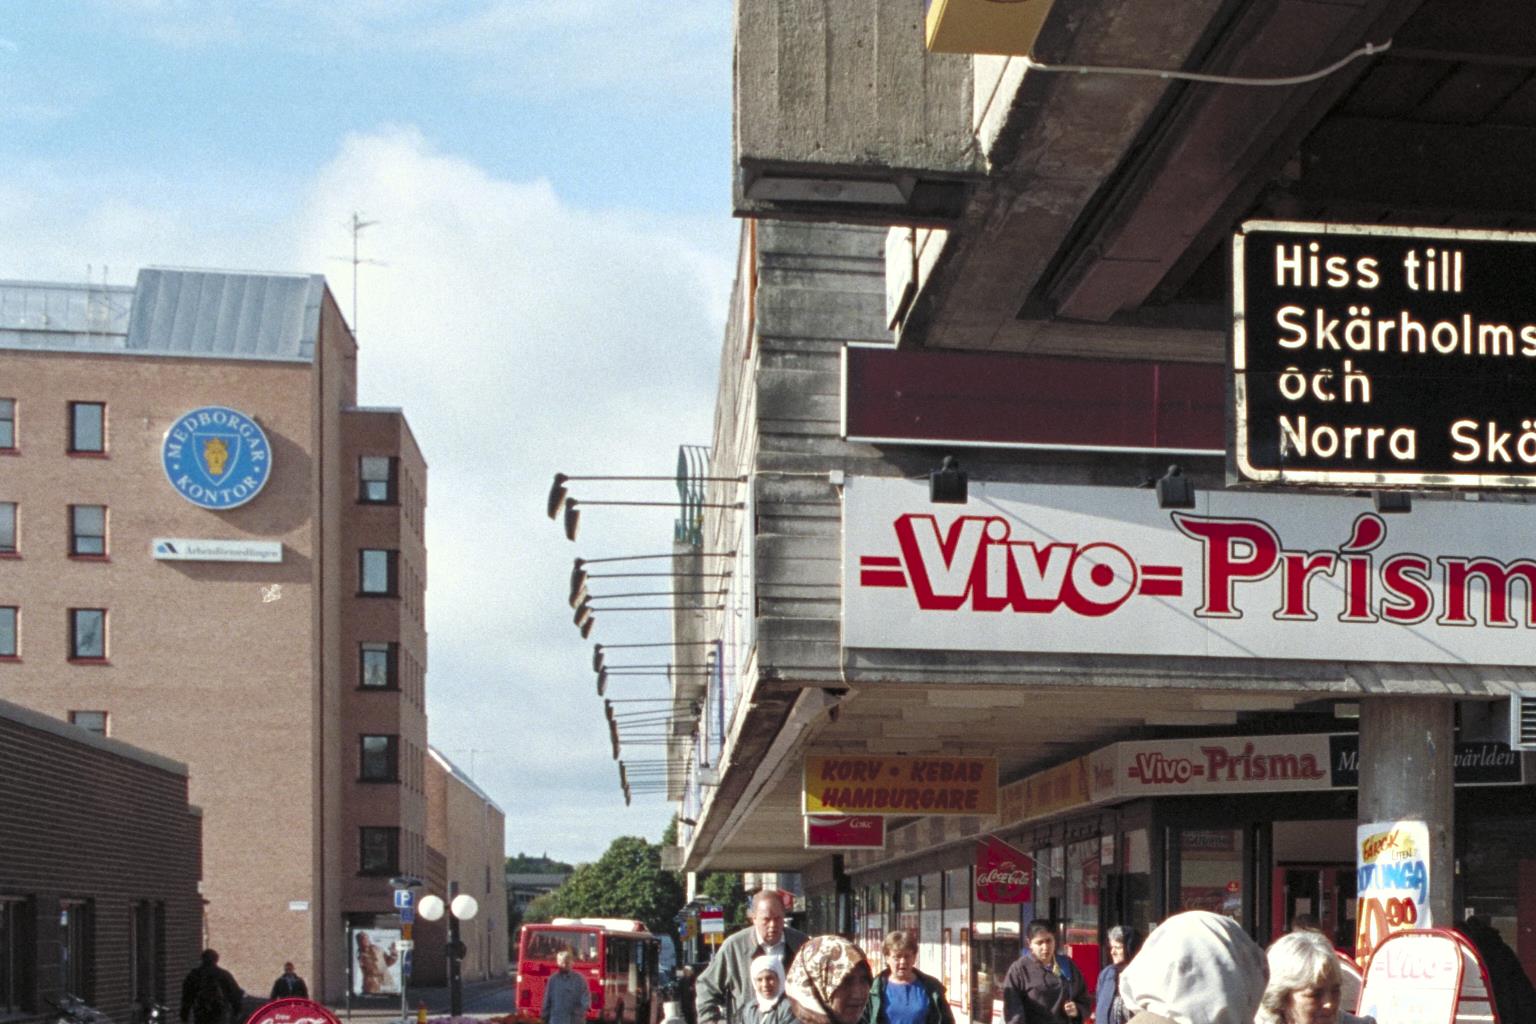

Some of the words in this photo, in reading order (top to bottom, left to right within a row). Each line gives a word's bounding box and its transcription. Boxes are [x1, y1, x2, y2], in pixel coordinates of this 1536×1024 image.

[1277, 244, 1379, 288] Hiss
[1404, 250, 1463, 292] till
[1278, 360, 1371, 403] och
[168, 412, 265, 461] MEDBORGAR
[1280, 416, 1417, 460] Norra
[177, 474, 257, 503] KONTOR
[821, 760, 883, 782] KORV
[911, 761, 985, 783] KEBAB
[1201, 743, 1326, 781] Prisma
[822, 787, 980, 810] HAMBURGARE
